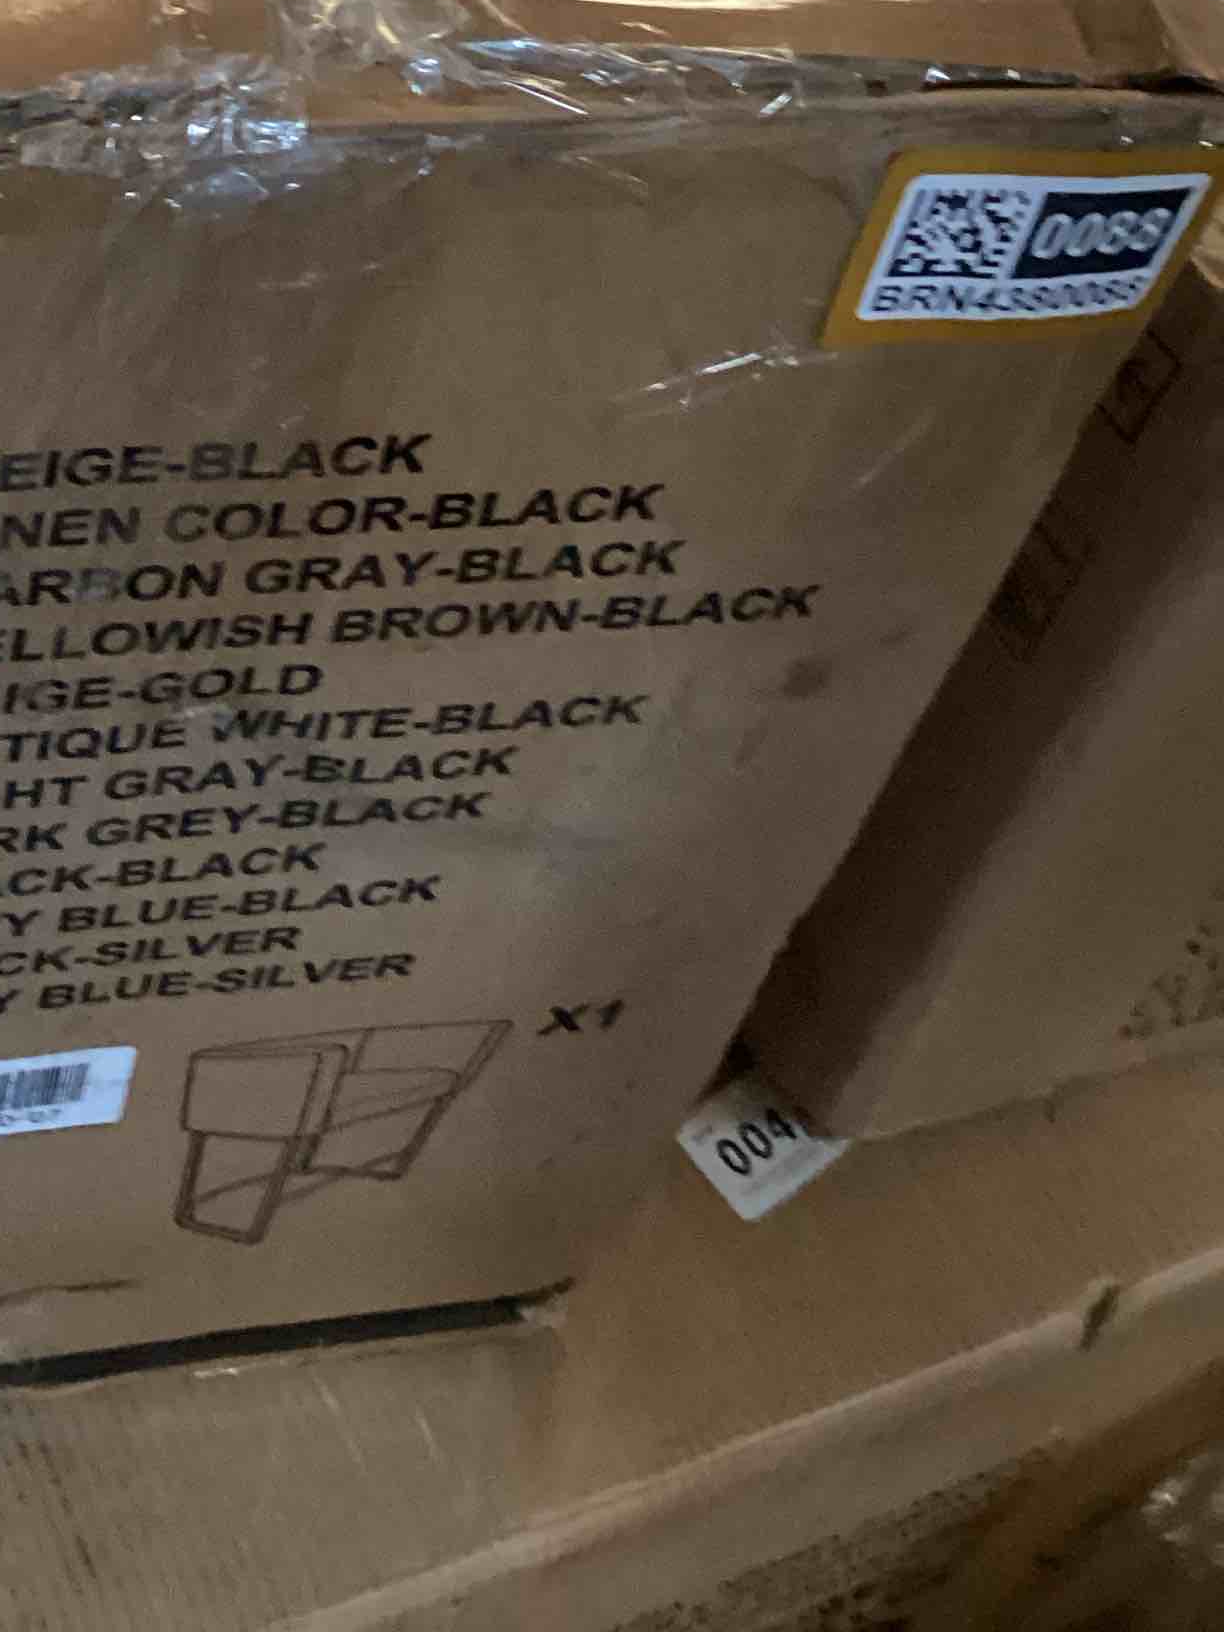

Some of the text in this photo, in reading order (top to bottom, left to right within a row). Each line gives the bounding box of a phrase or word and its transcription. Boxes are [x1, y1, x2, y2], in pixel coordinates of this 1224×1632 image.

[163, 483, 666, 545] COLOR-BLACK
[243, 539, 687, 596] GRAY-BLACK
[330, 584, 821, 644] BROWN-BLACK
[212, 694, 651, 743] WHITE-BLACK
[103, 745, 520, 800] GRAY-BLACK
[86, 791, 492, 848] GREY-BLACK
[57, 873, 442, 934] BLUE-BLACK
[37, 952, 417, 1010] BLUE-SILVER
[537, 999, 625, 1036] X1
